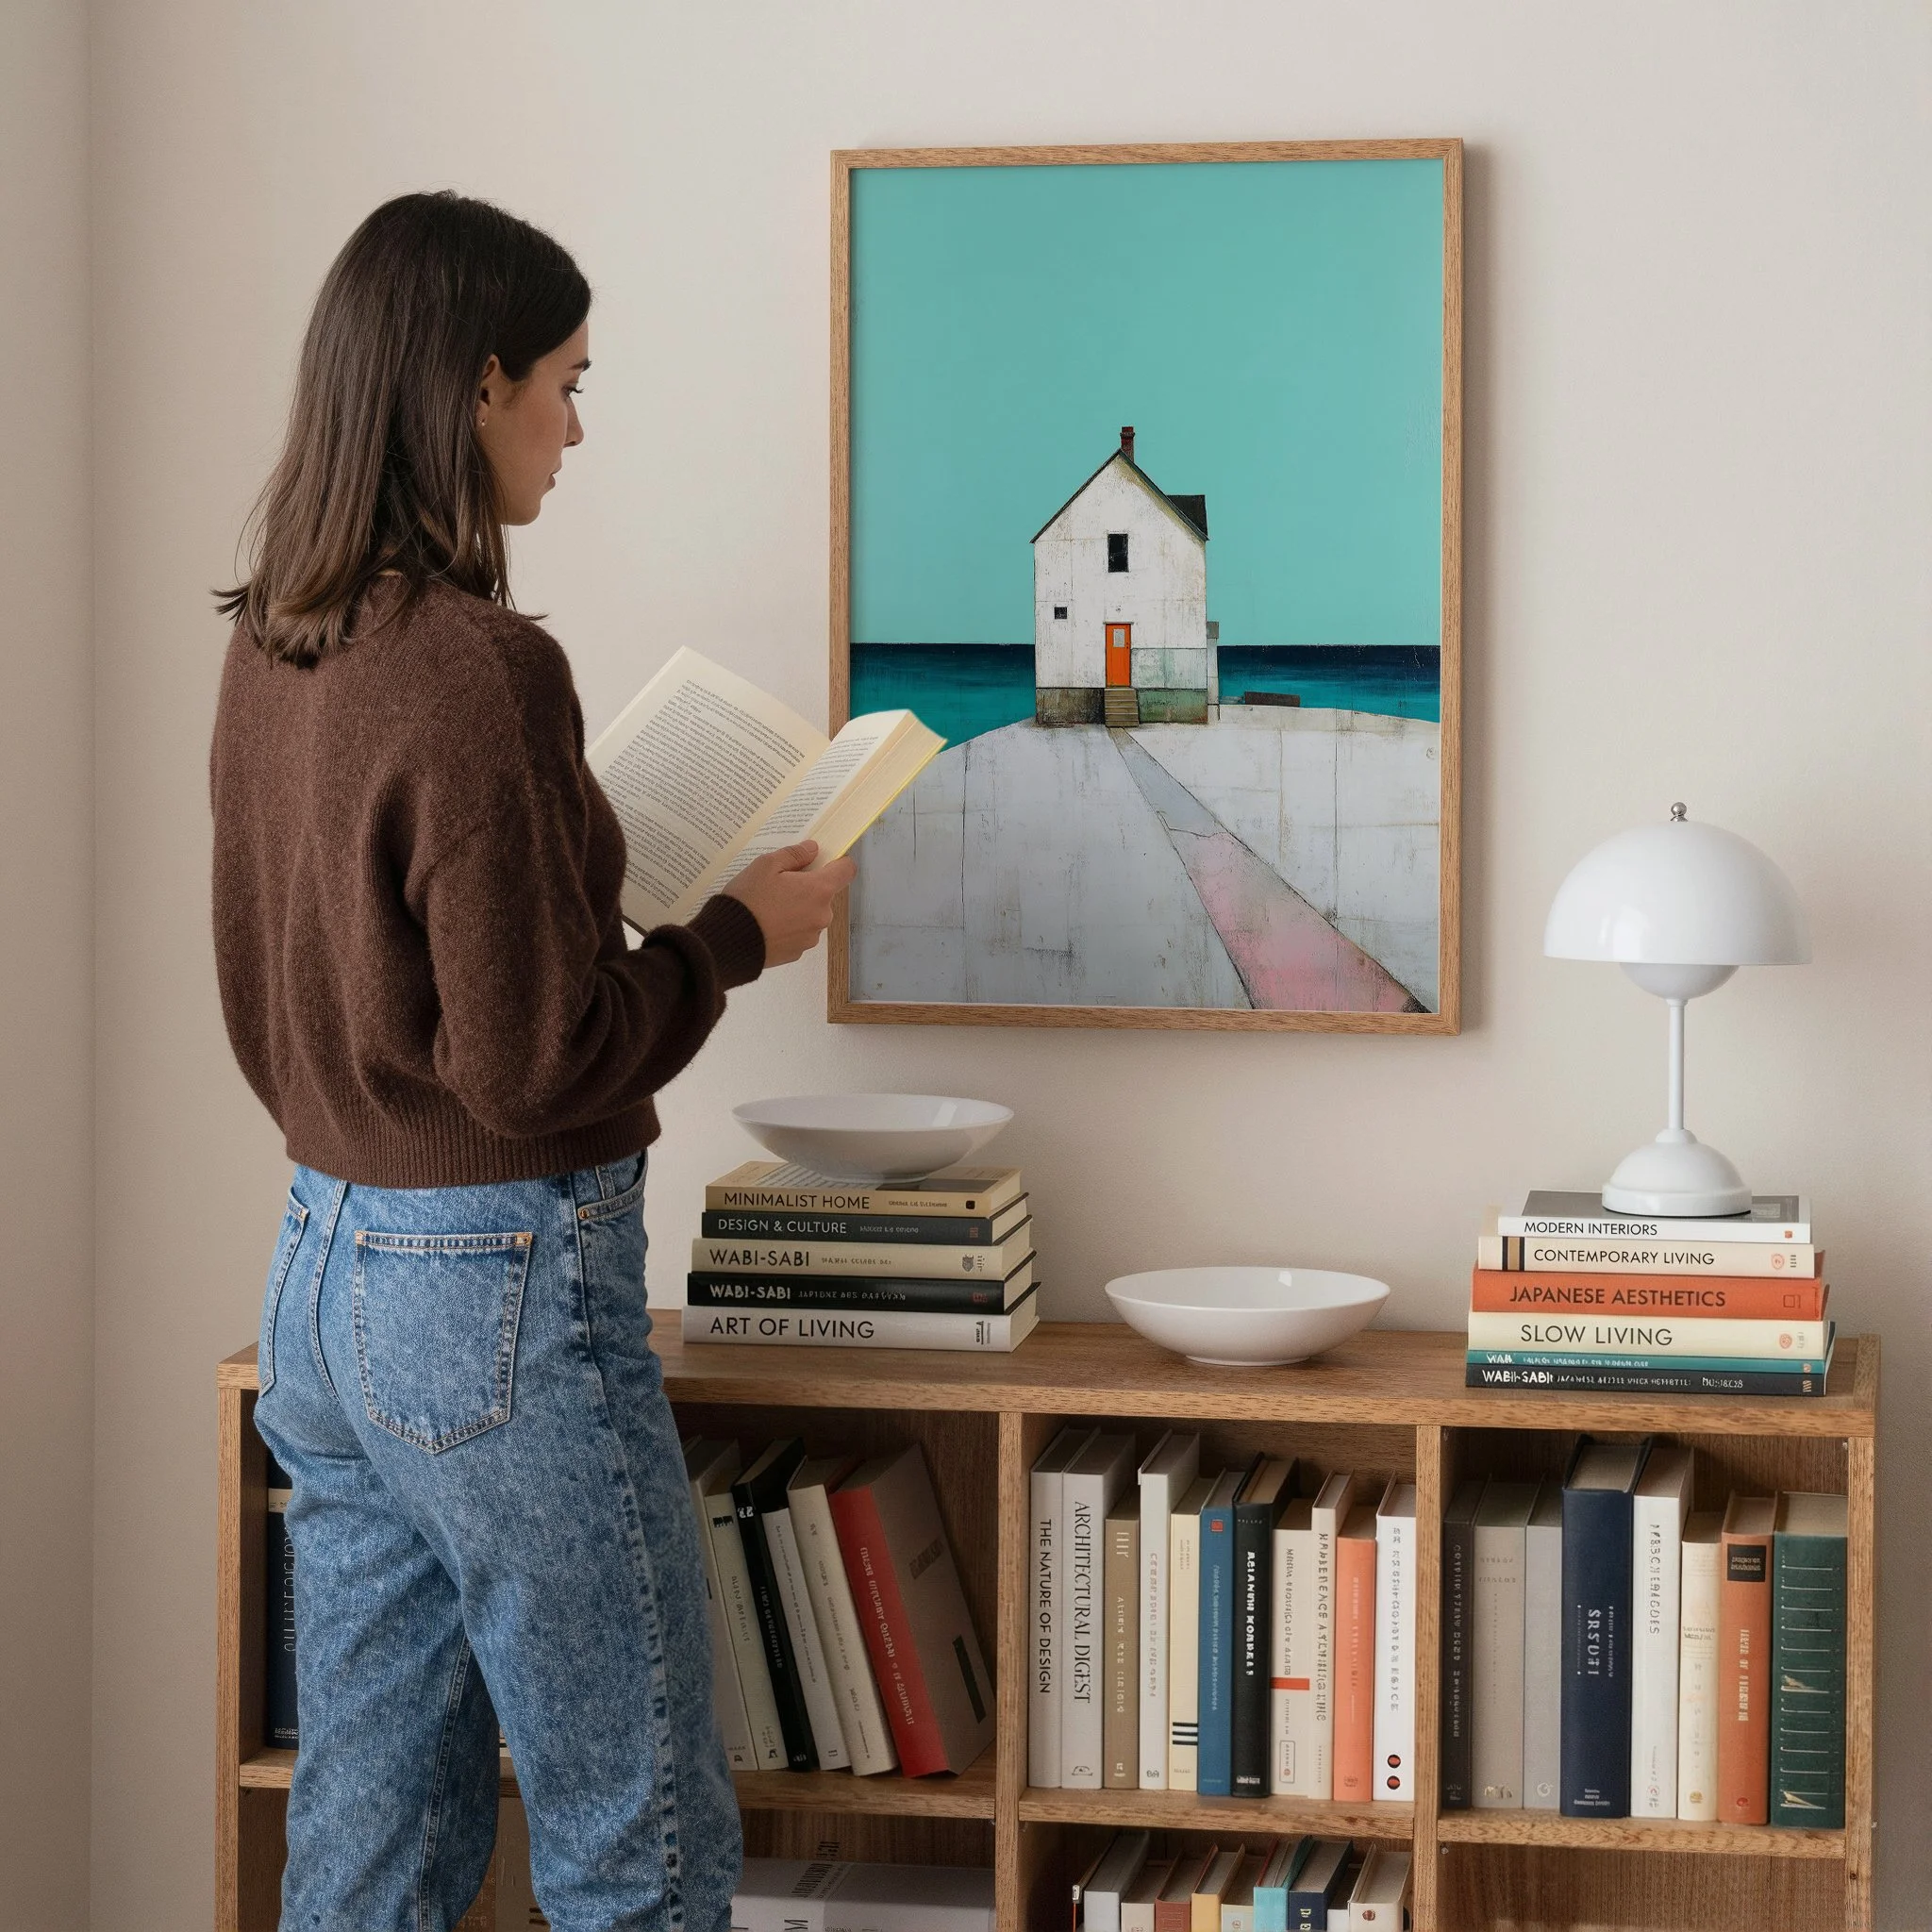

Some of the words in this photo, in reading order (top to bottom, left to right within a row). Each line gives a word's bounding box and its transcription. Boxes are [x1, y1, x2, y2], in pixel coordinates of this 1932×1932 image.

[724, 1191, 818, 1208] MINIMALIST
[822, 1194, 871, 1210] HOME
[718, 1218, 770, 1231] DESIGN
[773, 1220, 784, 1232] &
[787, 1220, 847, 1234] CULTURE
[1524, 1221, 1585, 1234] MODERN
[1588, 1223, 1657, 1236] INTERIORS
[708, 1248, 810, 1268] WABI-SABI
[1533, 1248, 1659, 1265] CONTEMPORARY
[1663, 1251, 1715, 1266] LIVING
[708, 1283, 791, 1300] WABI-SABI
[1509, 1285, 1606, 1305] JAPANESE
[1611, 1288, 1726, 1307] AESTHETICS
[709, 1316, 751, 1335] ART
[758, 1317, 790, 1336] OF
[798, 1318, 874, 1340] LIVING
[1520, 1324, 1587, 1343] SLOW
[1594, 1325, 1674, 1346] LIVING
[1040, 1518, 1052, 1547] THE
[1039, 1552, 1052, 1608] NATURE
[1073, 1500, 1091, 1641] ARCHITECTURAL
[1039, 1612, 1051, 1633] OF
[1038, 1638, 1051, 1693] DESIGN
[1073, 1644, 1091, 1704] DIGEST
